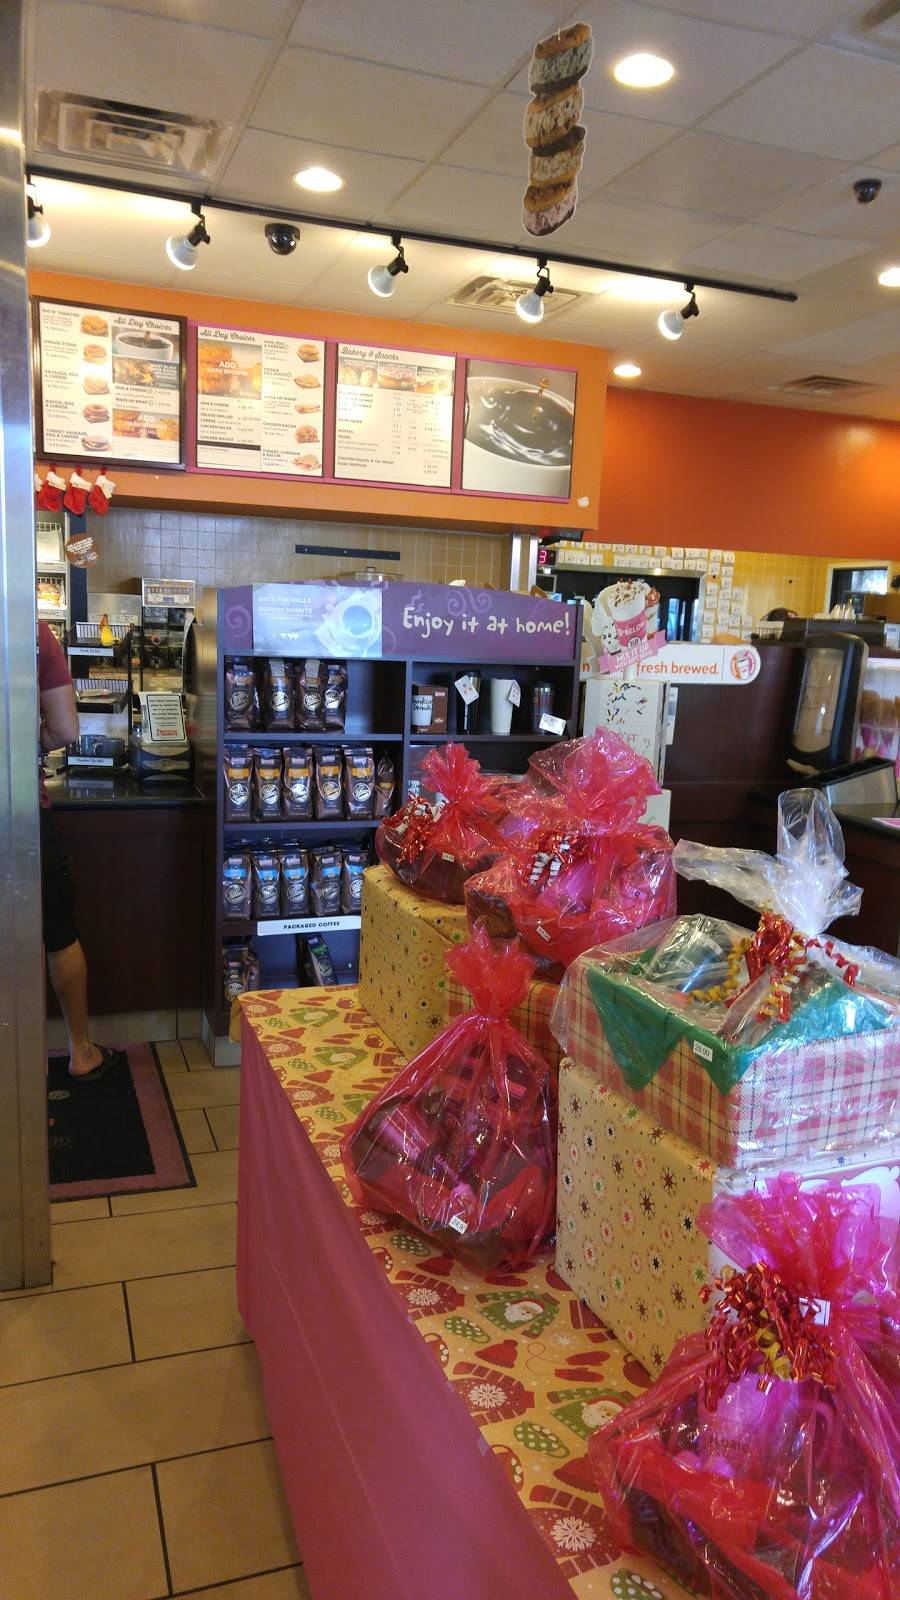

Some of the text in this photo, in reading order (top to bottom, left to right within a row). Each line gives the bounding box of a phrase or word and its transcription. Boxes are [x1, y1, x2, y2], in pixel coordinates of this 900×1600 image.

[127, 318, 144, 329] Day
[144, 320, 172, 331] Choices
[213, 330, 229, 340] Day
[229, 331, 256, 342] Choices
[341, 347, 368, 359] Bakery
[374, 351, 400, 361] Snacks
[403, 605, 570, 639] Enjoy it at home!
[639, 643, 650, 653] UP
[636, 659, 668, 677] fresh
[671, 660, 720, 675] brewed.
[283, 920, 340, 931] PACKAGED COFFEE
